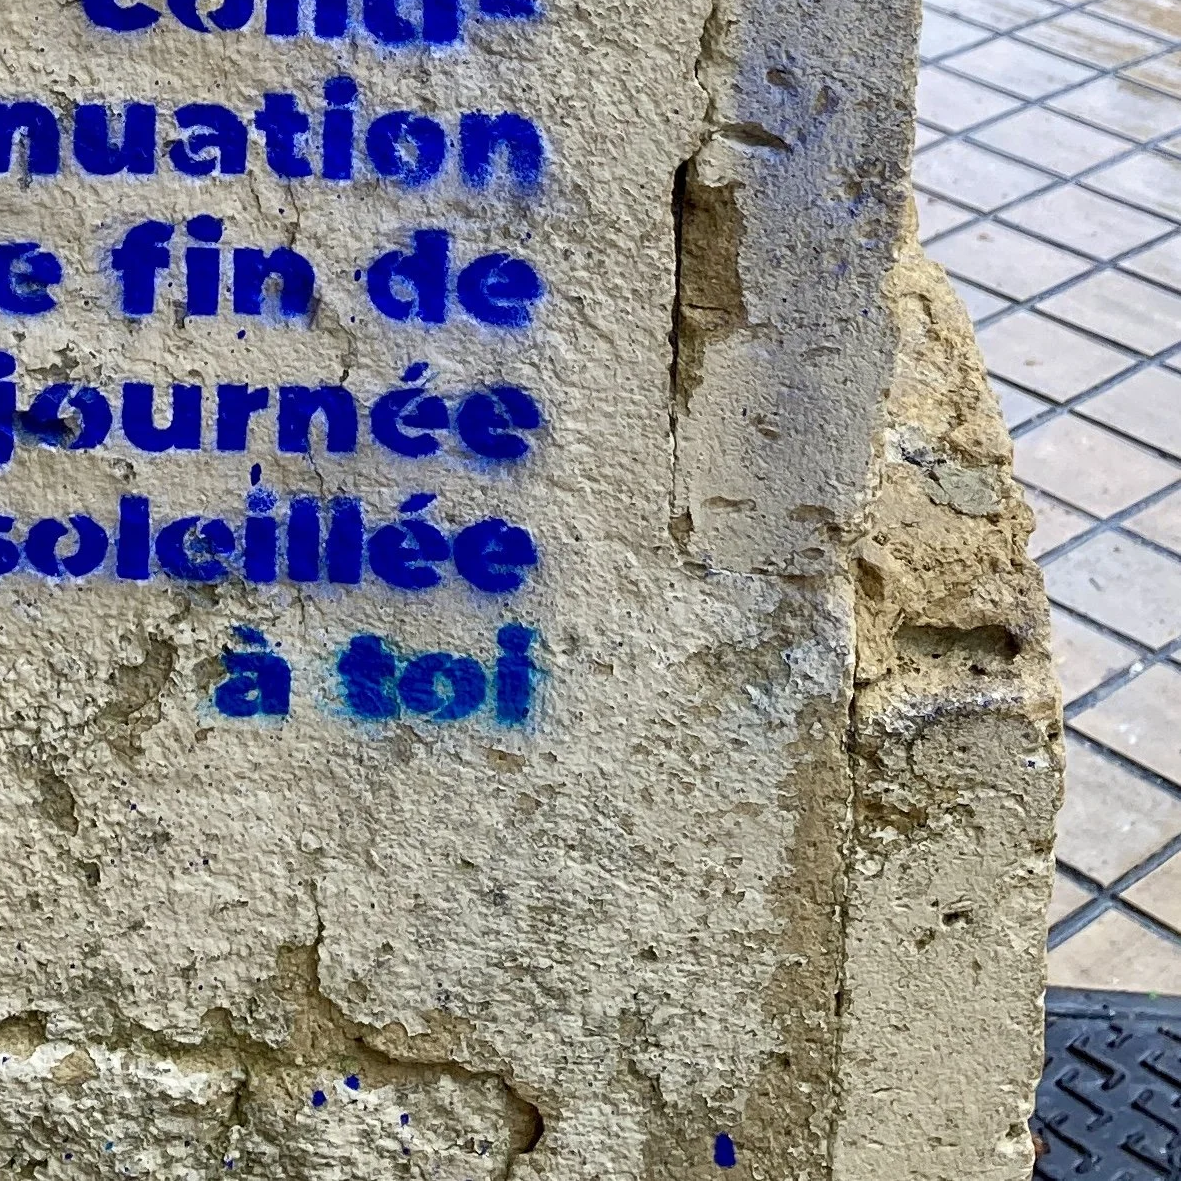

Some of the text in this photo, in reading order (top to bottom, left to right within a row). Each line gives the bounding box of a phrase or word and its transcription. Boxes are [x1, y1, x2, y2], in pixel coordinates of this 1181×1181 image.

[111, 215, 316, 318] fin
[367, 229, 544, 326] de
[214, 623, 537, 724] à toi
